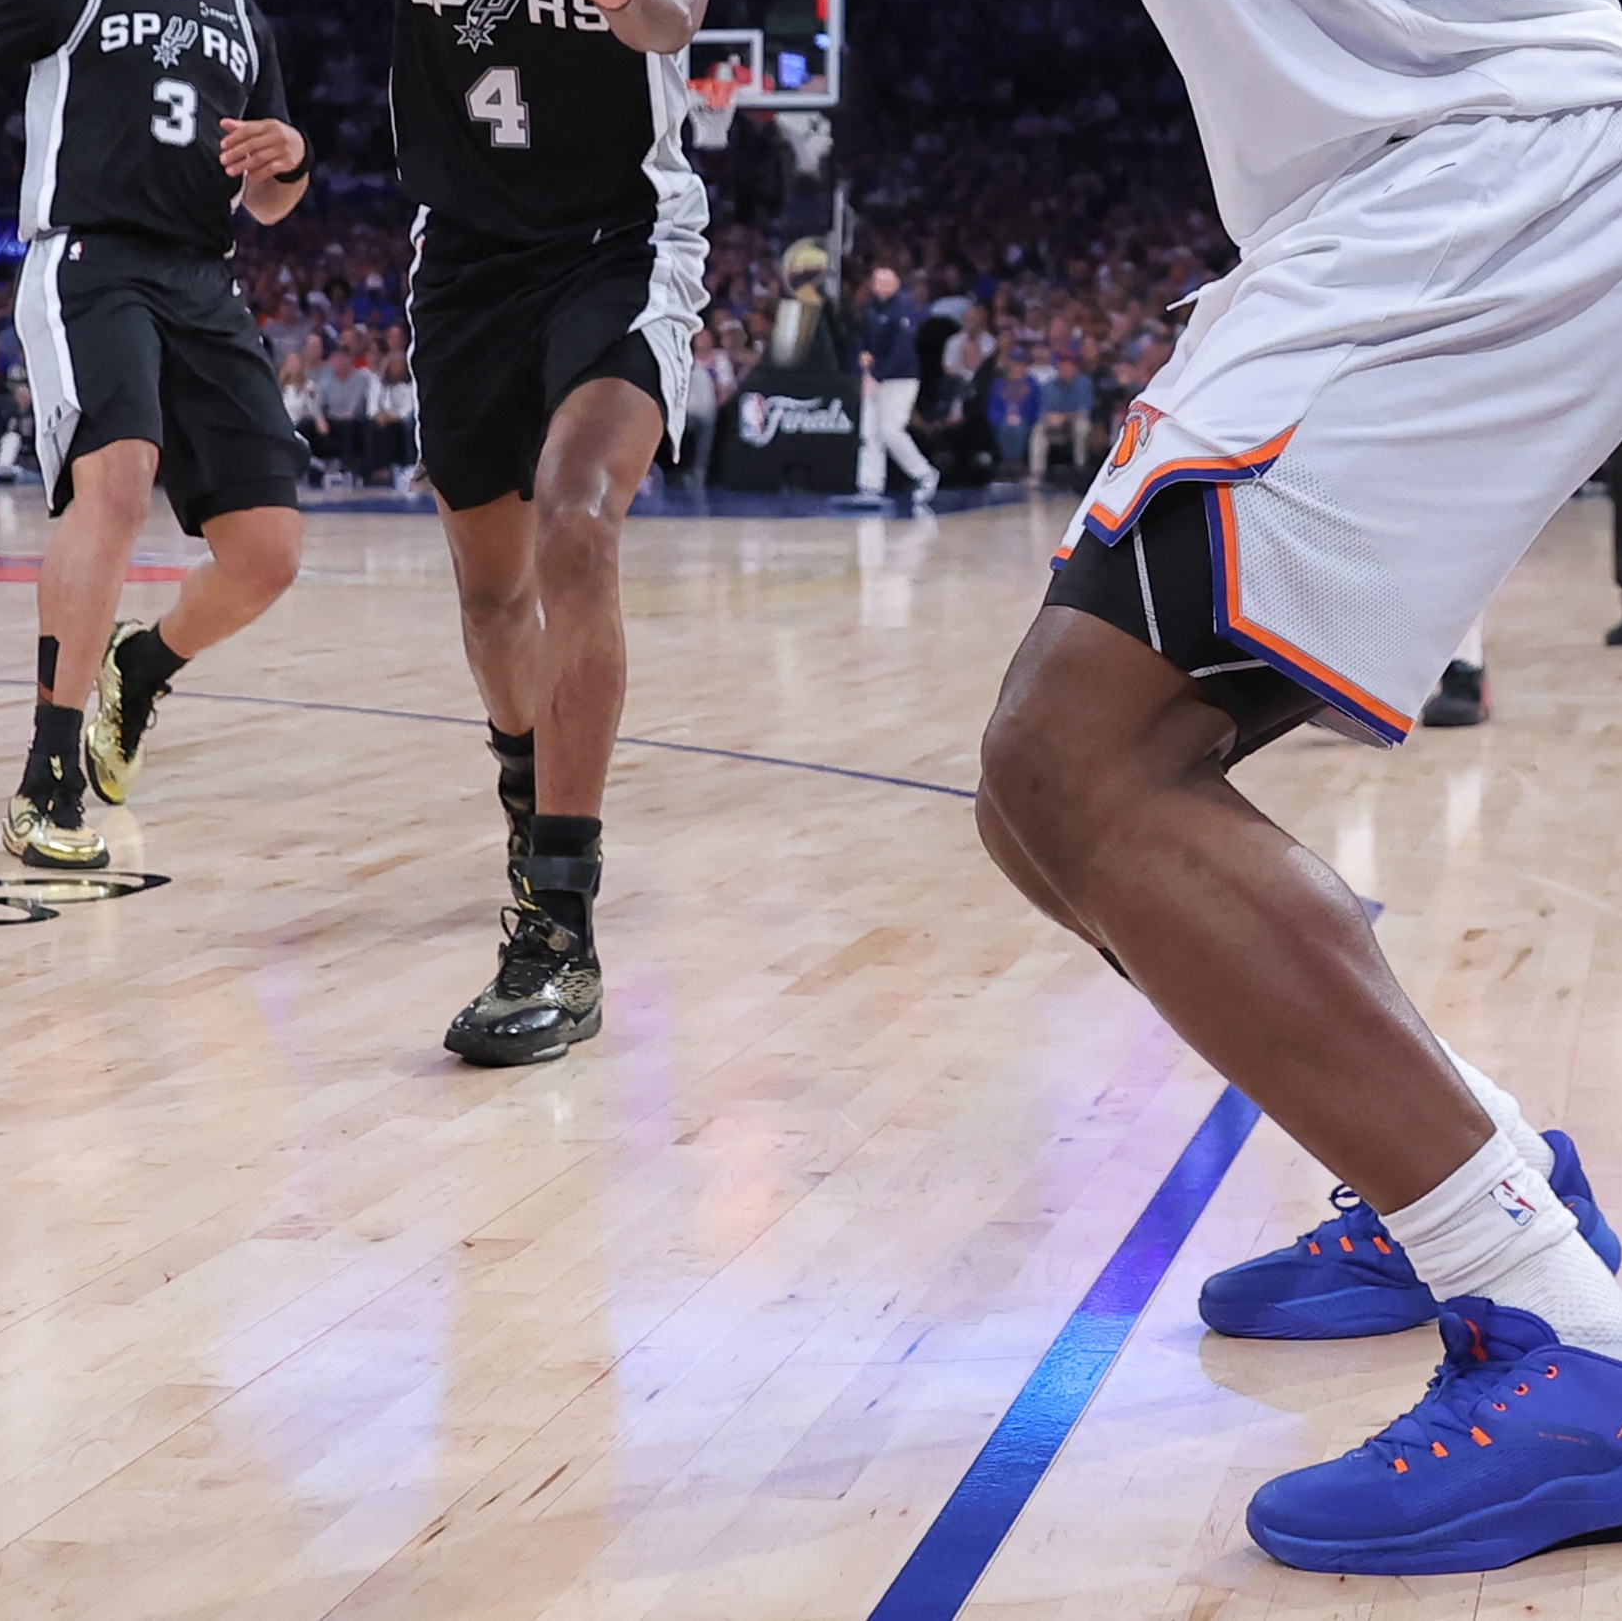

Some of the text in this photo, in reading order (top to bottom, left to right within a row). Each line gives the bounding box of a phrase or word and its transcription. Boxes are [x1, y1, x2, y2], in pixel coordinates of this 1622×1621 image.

[151, 77, 199, 147] 3
[464, 65, 531, 148] 4
[751, 394, 854, 448] Finals
